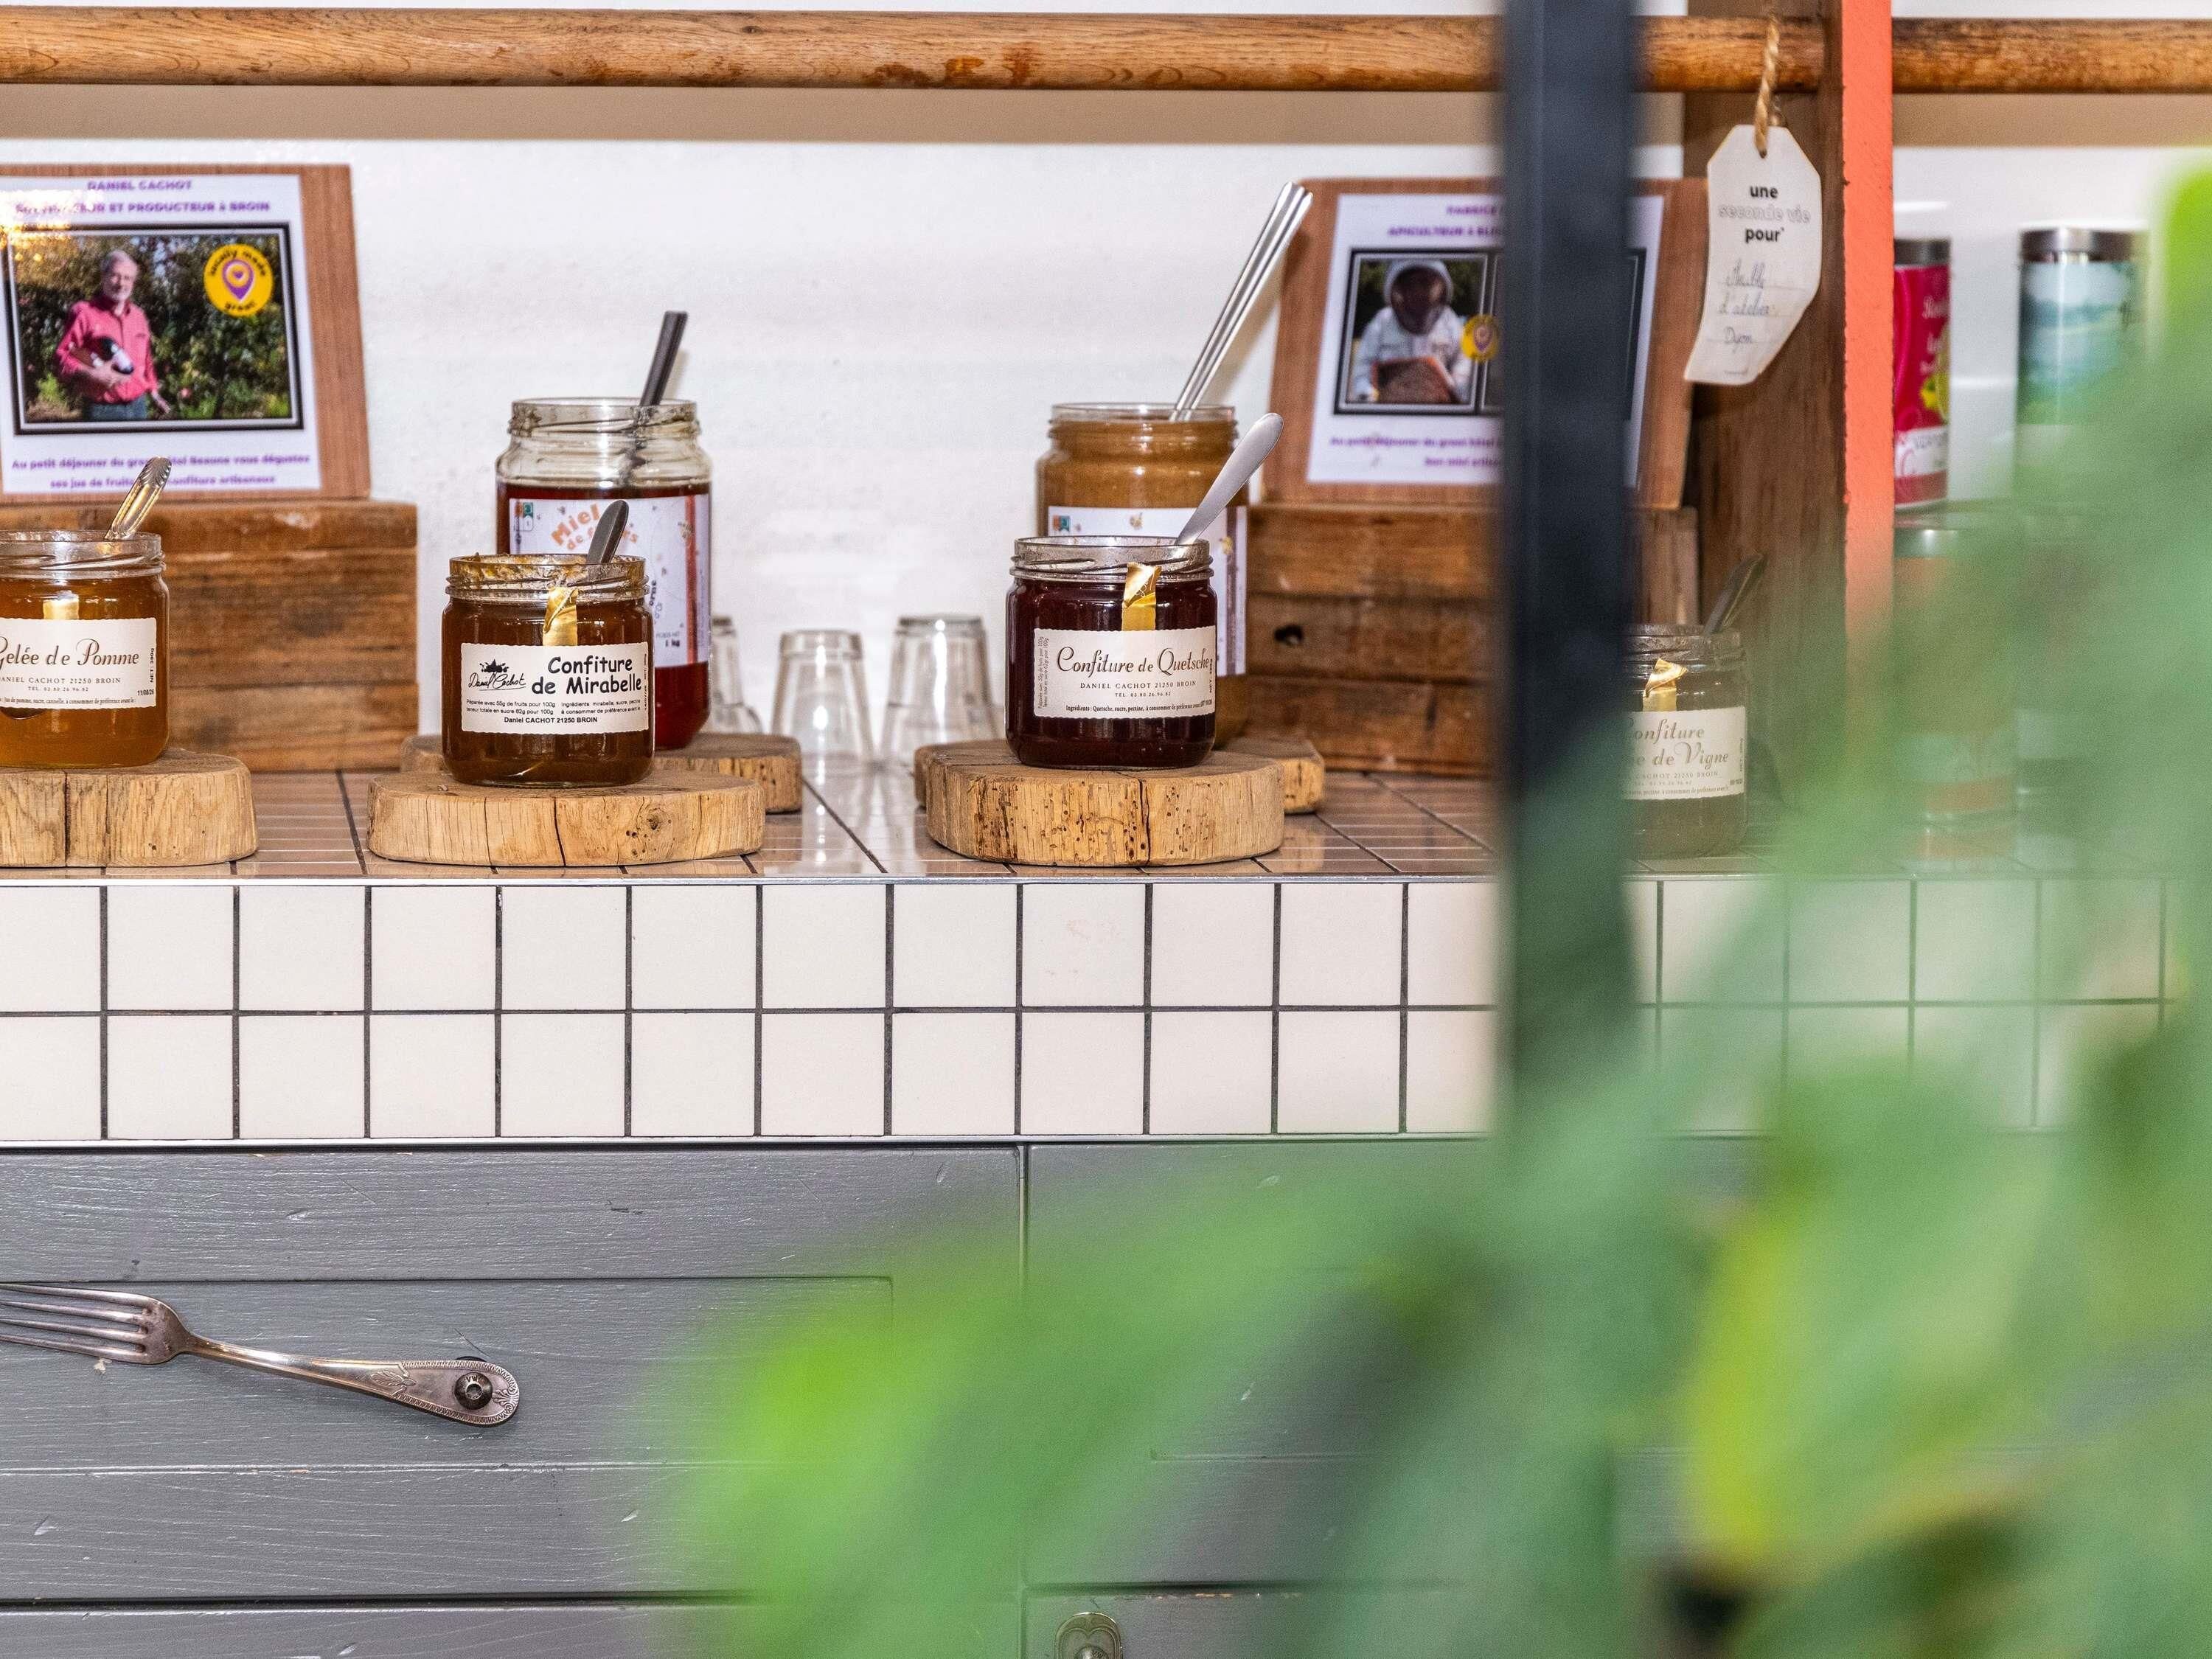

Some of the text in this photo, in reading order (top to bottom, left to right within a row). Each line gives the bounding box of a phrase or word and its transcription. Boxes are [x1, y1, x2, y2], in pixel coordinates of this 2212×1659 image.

[87, 180, 191, 190] DANIEL CACHOT
[1750, 186, 1778, 198] une
[128, 202, 215, 212] PRODUCTEUR
[230, 201, 270, 212] BROIN
[12, 459, 27, 469] Au
[30, 459, 55, 470] petit
[111, 458, 124, 467] du
[552, 504, 599, 546] Miel
[46, 645, 71, 665] de
[76, 639, 139, 666] Pomme
[1057, 646, 1209, 678] Confiture de Quetsche
[548, 655, 633, 675] Confiture
[532, 673, 641, 695] de Mirabelle
[1652, 748, 1674, 765] de
[1674, 742, 1729, 770] Vigne
